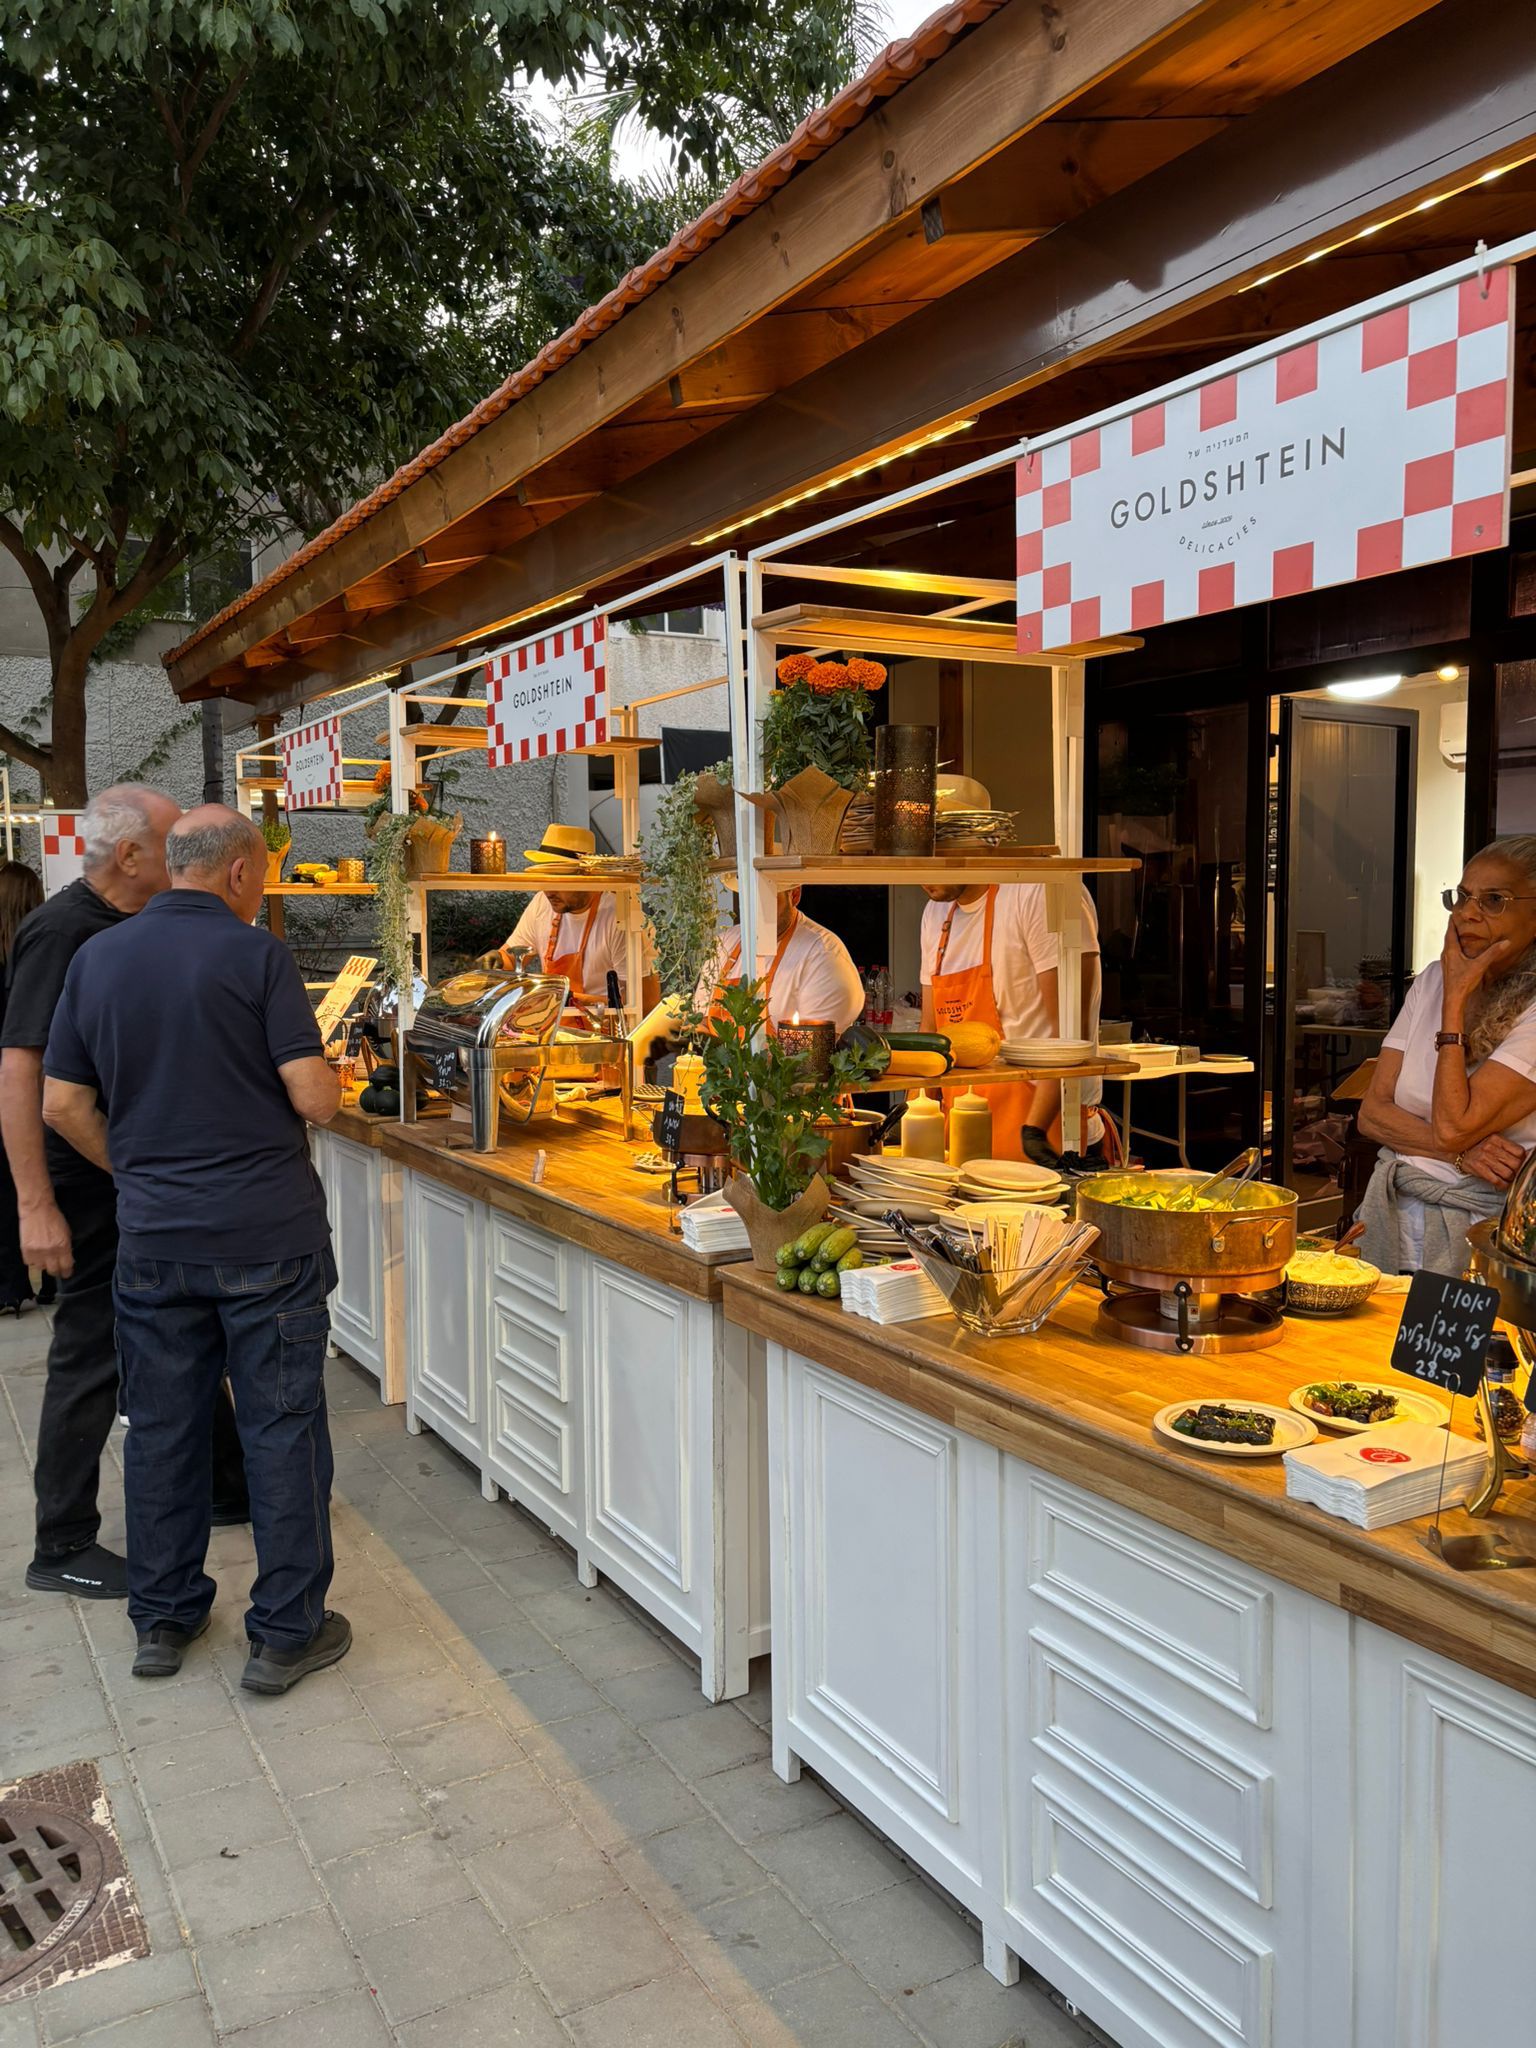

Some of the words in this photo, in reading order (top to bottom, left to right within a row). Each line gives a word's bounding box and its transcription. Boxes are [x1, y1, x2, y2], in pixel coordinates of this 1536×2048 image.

[1110, 426, 1345, 529] GOLDSHTEIN
[1179, 516, 1257, 553] DELICACIES
[513, 676, 573, 709] GOLDSHTEIN
